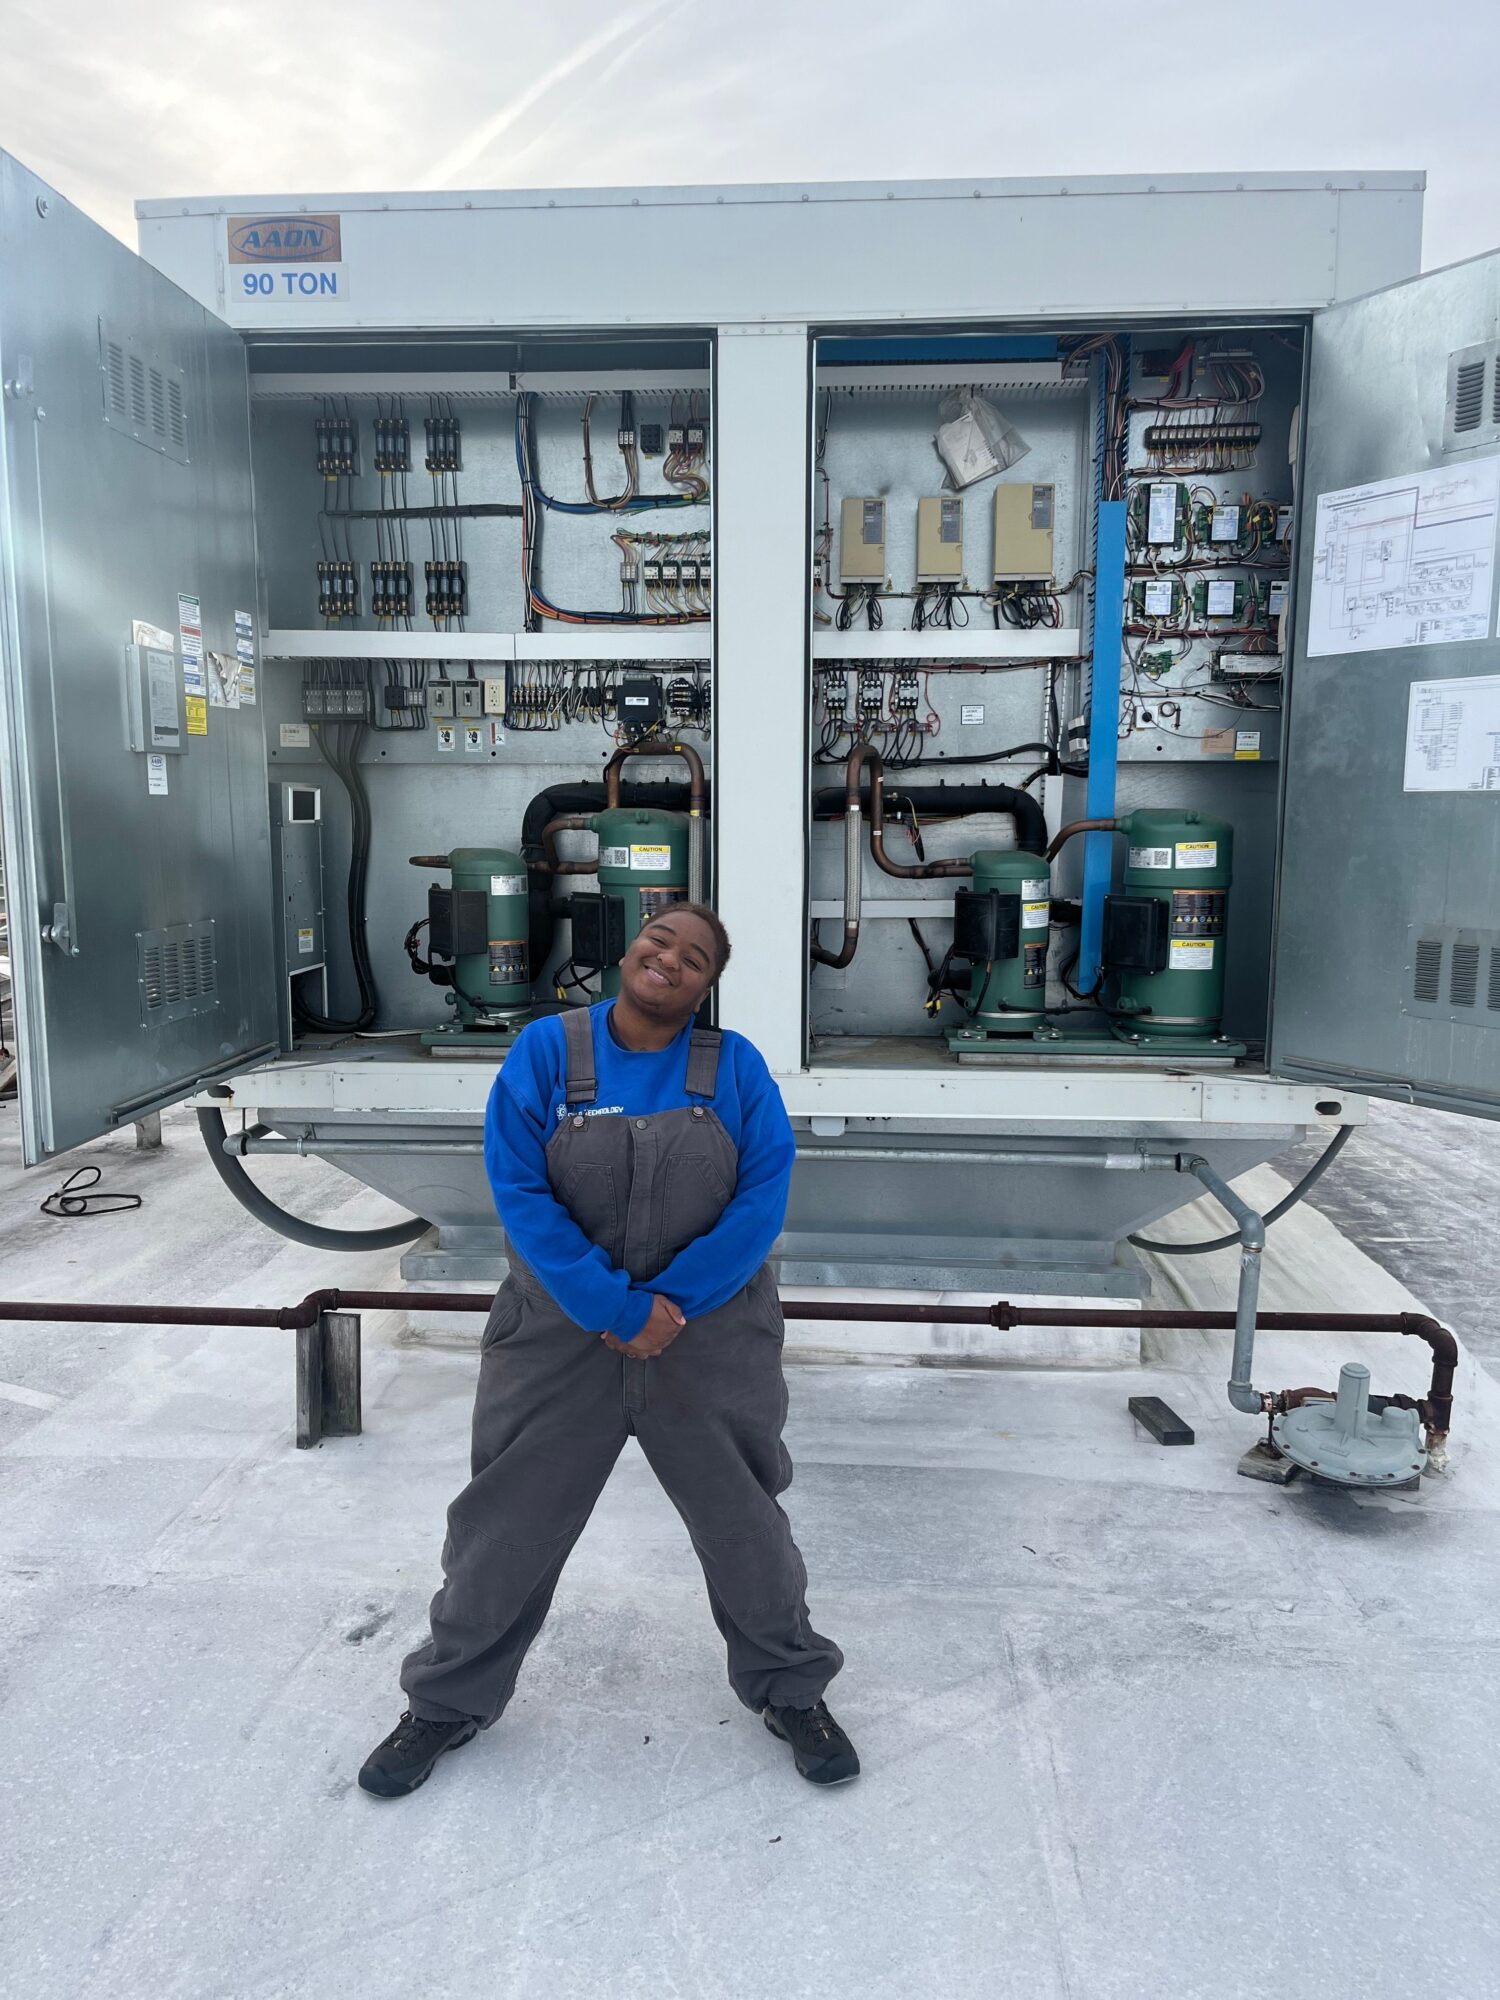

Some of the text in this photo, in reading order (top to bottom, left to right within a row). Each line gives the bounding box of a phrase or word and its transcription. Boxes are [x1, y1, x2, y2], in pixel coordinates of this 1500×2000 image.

[240, 229, 324, 249] AAON
[243, 272, 337, 295] 90 TON
